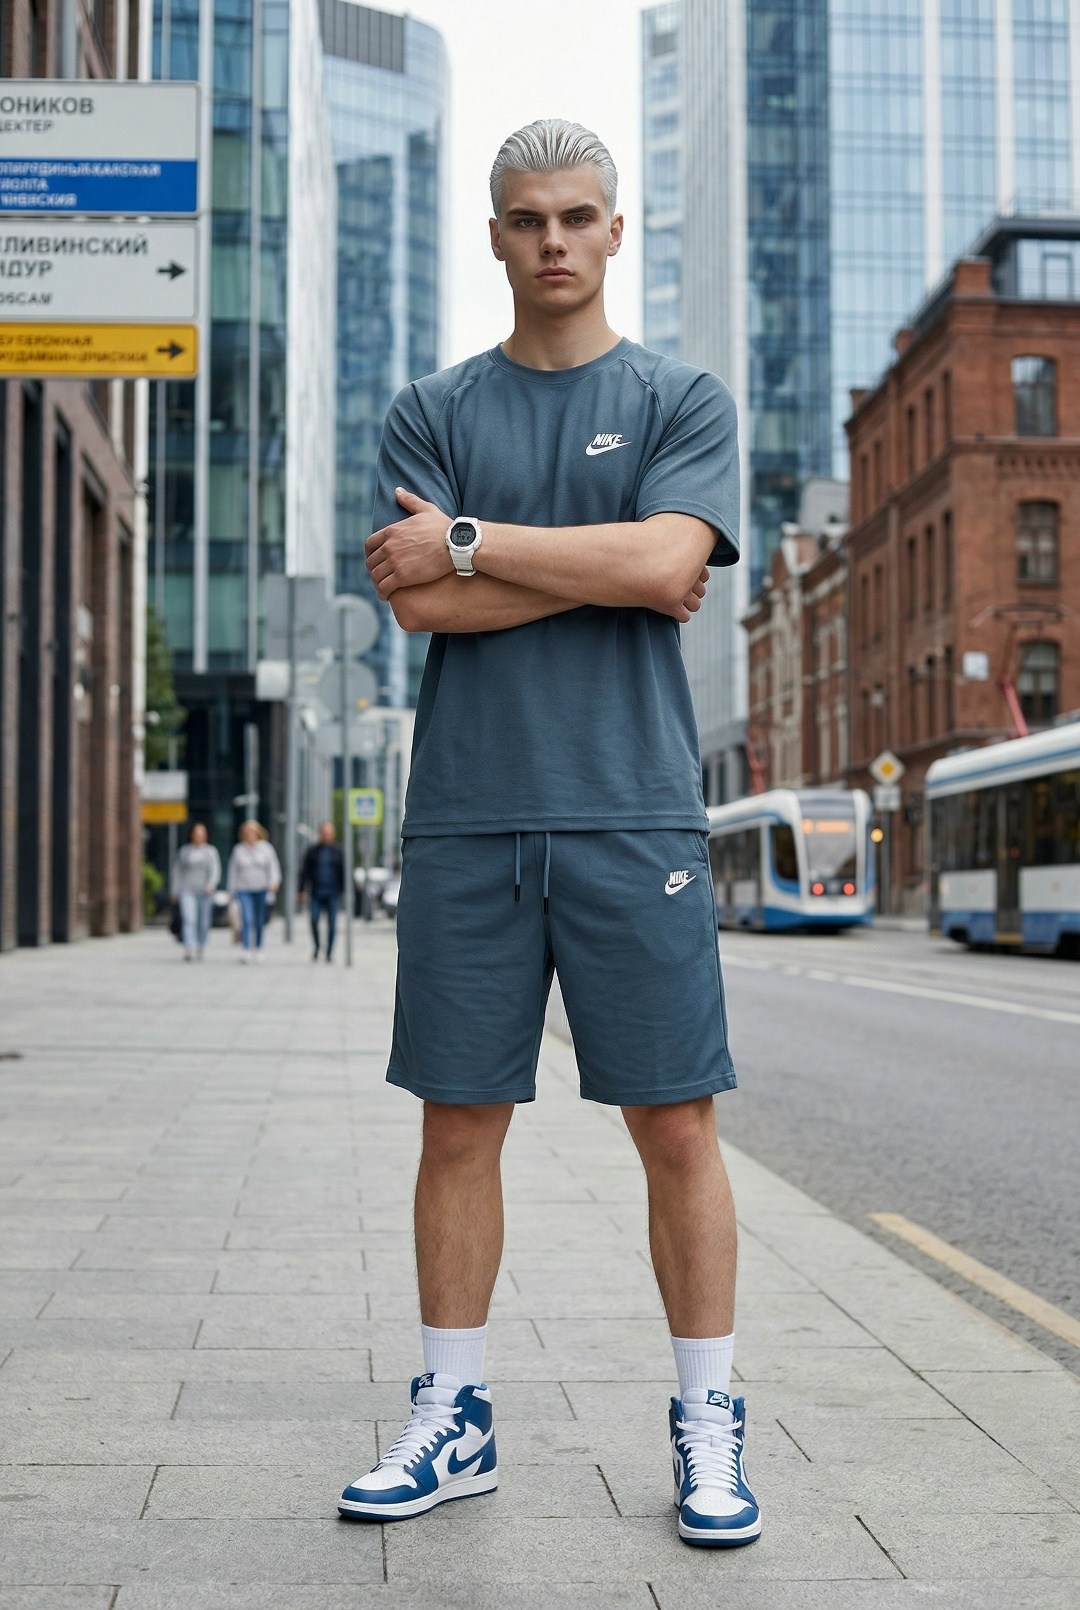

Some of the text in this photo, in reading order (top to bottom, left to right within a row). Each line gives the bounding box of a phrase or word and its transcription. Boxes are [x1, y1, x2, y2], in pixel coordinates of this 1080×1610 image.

[0, 97, 94, 114] ОНИКОВ
[0, 234, 148, 255] ЛИВИНСКИЙ
[592, 433, 623, 446] NIKE
